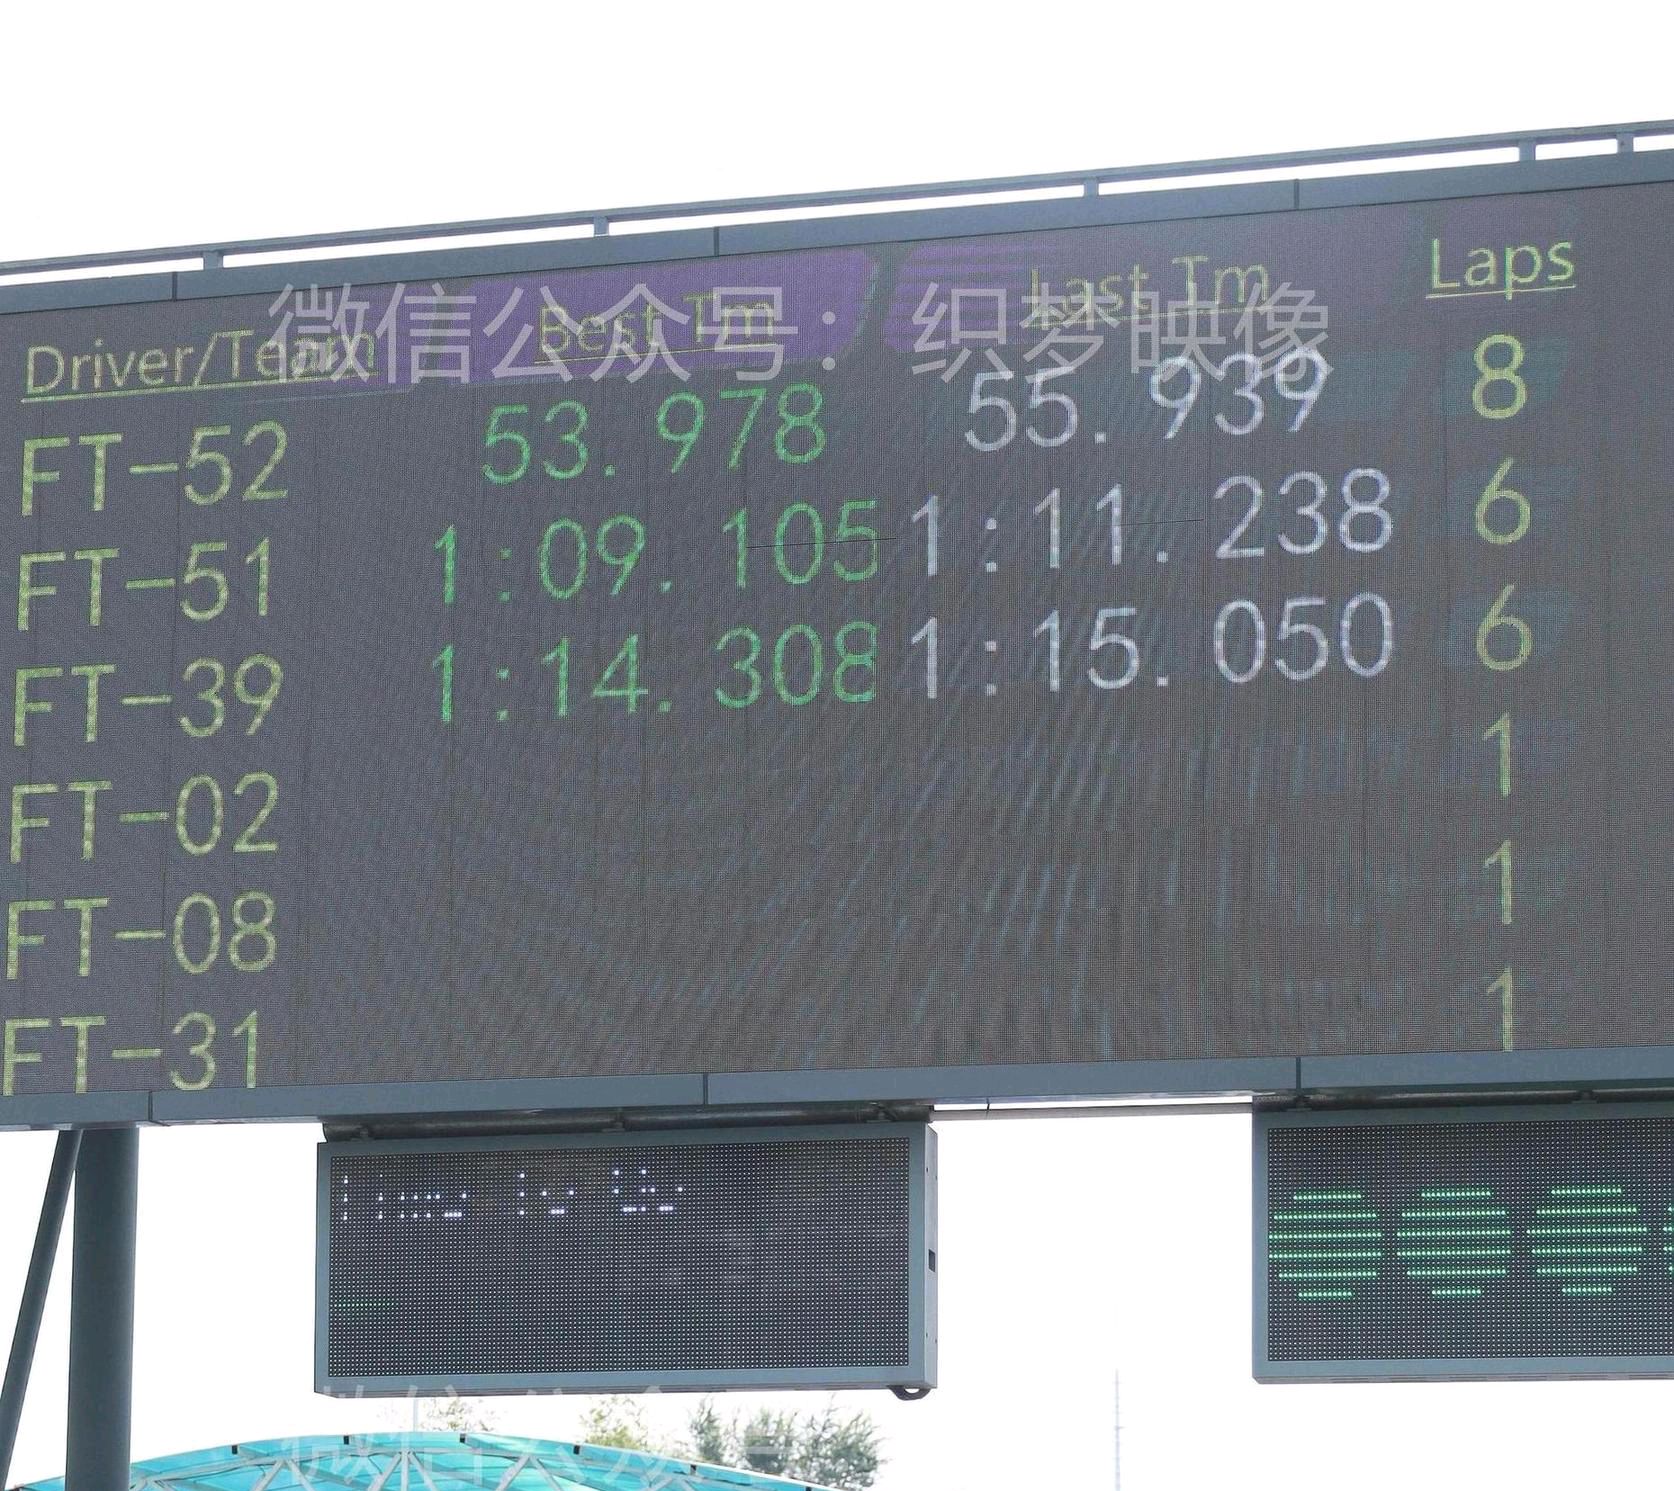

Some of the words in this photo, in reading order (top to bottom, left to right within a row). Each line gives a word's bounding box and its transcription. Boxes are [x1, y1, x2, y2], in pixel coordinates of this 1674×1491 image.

[539, 302, 659, 353] Best
[683, 290, 776, 343] Tm
[1030, 264, 1150, 317] Last
[1172, 255, 1270, 306] Tm
[1431, 238, 1575, 300] Laps
[20, 421, 289, 516] FT-52
[1472, 334, 1527, 419] 8
[26, 325, 379, 397] Driver/Team
[16, 538, 271, 631] FT-51
[1475, 457, 1532, 546] 6
[13, 654, 284, 747] FT-39
[1477, 584, 1533, 672] 6
[10, 772, 280, 863] FT-02
[1483, 712, 1511, 797] 1
[6, 892, 277, 980] FT-08
[1484, 839, 1513, 925] 1
[2, 1010, 260, 1096] FT-31
[1486, 966, 1514, 1051] 1
